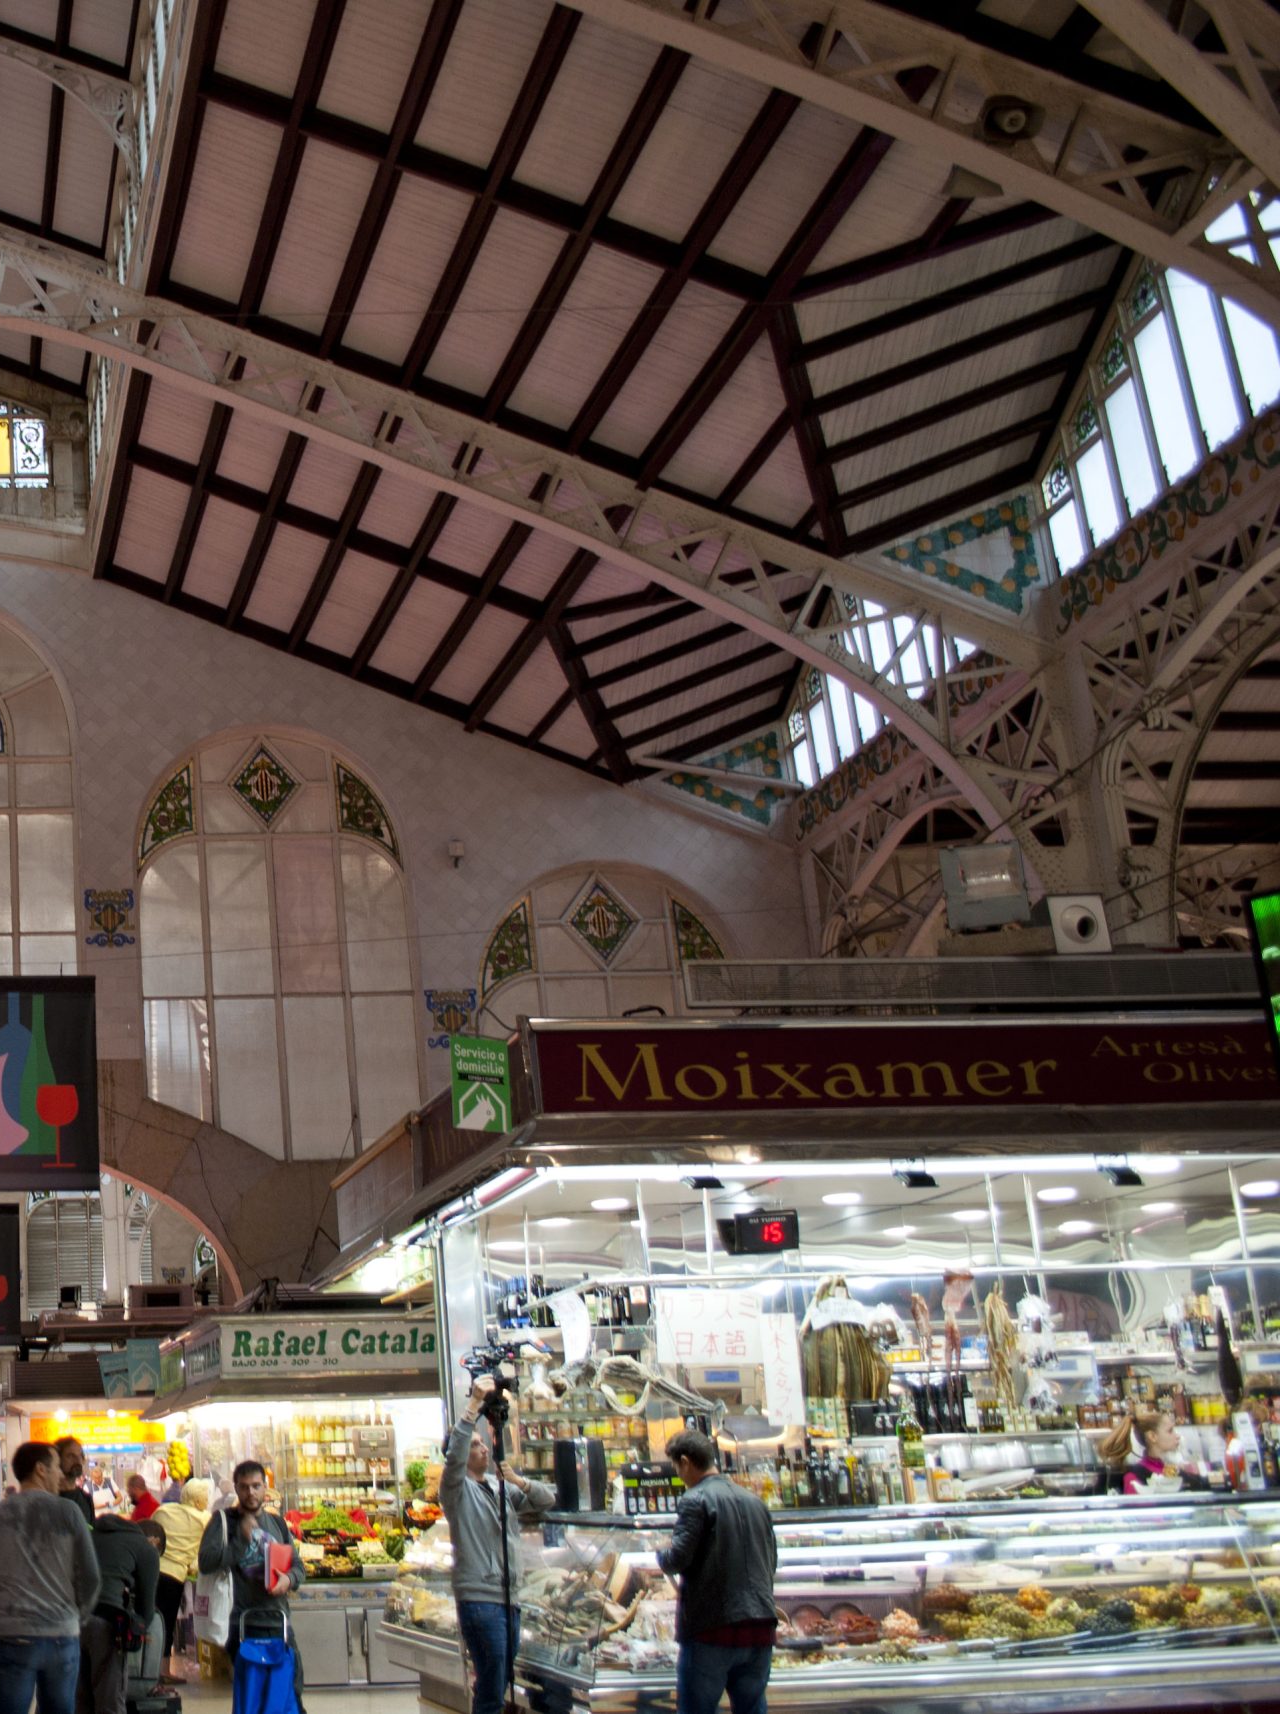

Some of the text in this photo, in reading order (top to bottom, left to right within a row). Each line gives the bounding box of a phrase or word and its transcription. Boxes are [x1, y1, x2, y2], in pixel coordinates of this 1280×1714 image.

[454, 1043, 505, 1062] Servicio a
[1091, 1034, 1247, 1057] Artesà
[577, 1043, 1057, 1101] Moixamer
[763, 1222, 784, 1243] 15
[232, 1329, 327, 1357] Rafael
[675, 1330, 747, 1358] 日本語
[232, 1359, 257, 1367] BAJO
[322, 1358, 338, 1366] 310
